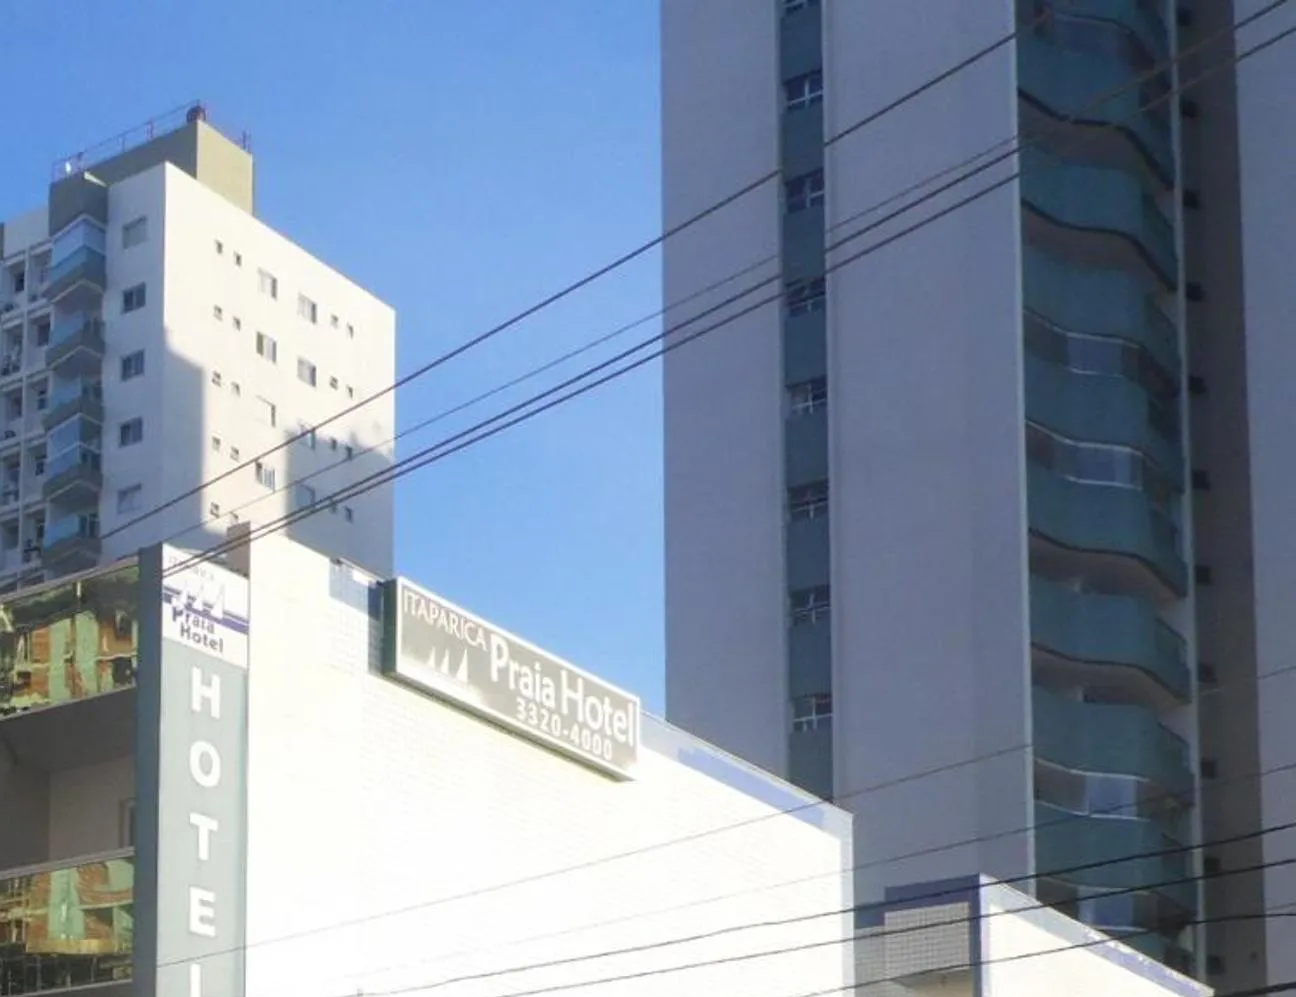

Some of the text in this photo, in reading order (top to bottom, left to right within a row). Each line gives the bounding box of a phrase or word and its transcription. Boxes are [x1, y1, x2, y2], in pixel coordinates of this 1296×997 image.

[180, 621, 224, 653] Hotel
[404, 588, 487, 651] ITAPARICA
[489, 632, 634, 747] Praia Hotel
